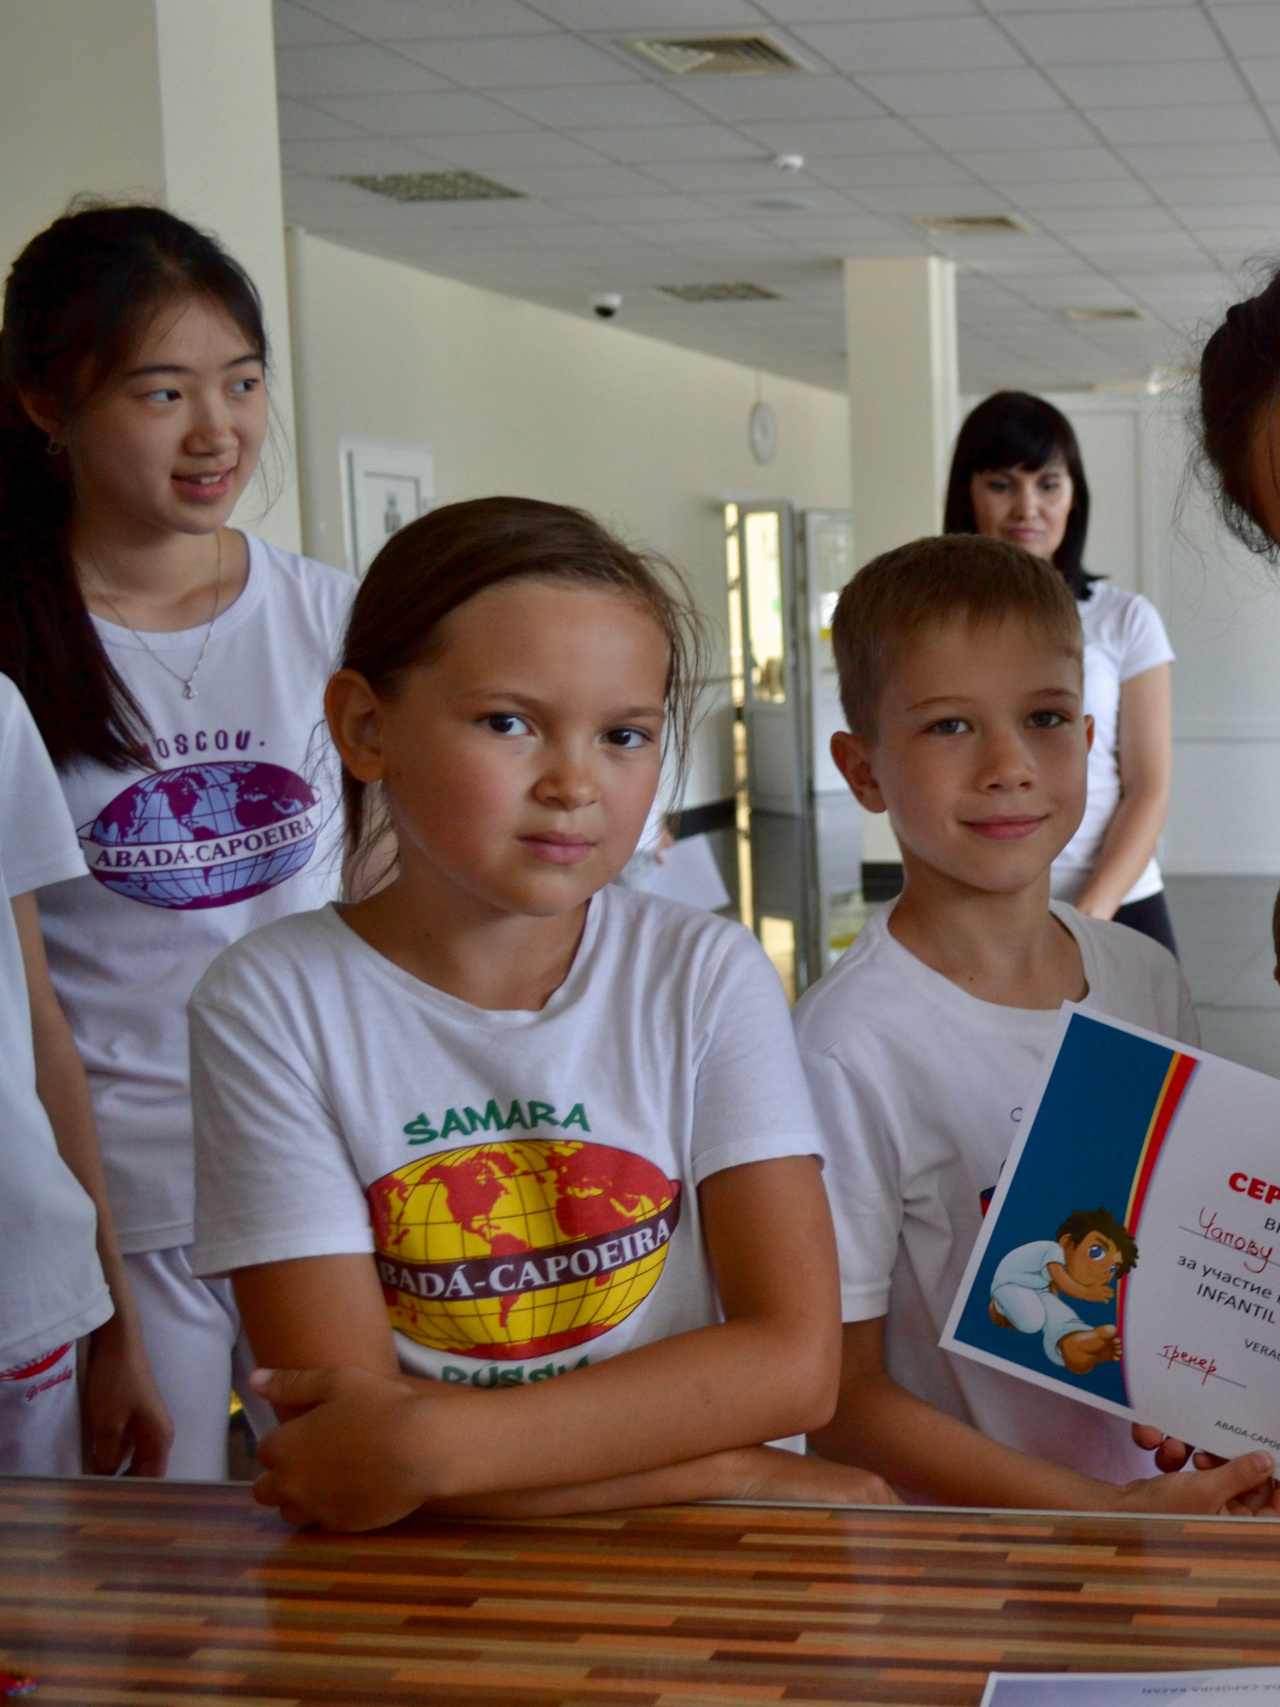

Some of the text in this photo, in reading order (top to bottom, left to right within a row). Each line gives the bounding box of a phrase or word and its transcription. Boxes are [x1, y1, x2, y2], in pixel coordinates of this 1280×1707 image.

[95, 815, 314, 868] ABADÁ-CAPOEIRA
[403, 1098, 591, 1145] SAMARA
[380, 1218, 670, 1299] BADÁ-CAPOEIRA
[1177, 1255, 1196, 1270] за
[1202, 1264, 1272, 1299] участие
[1197, 1283, 1276, 1325] INFANTIL
